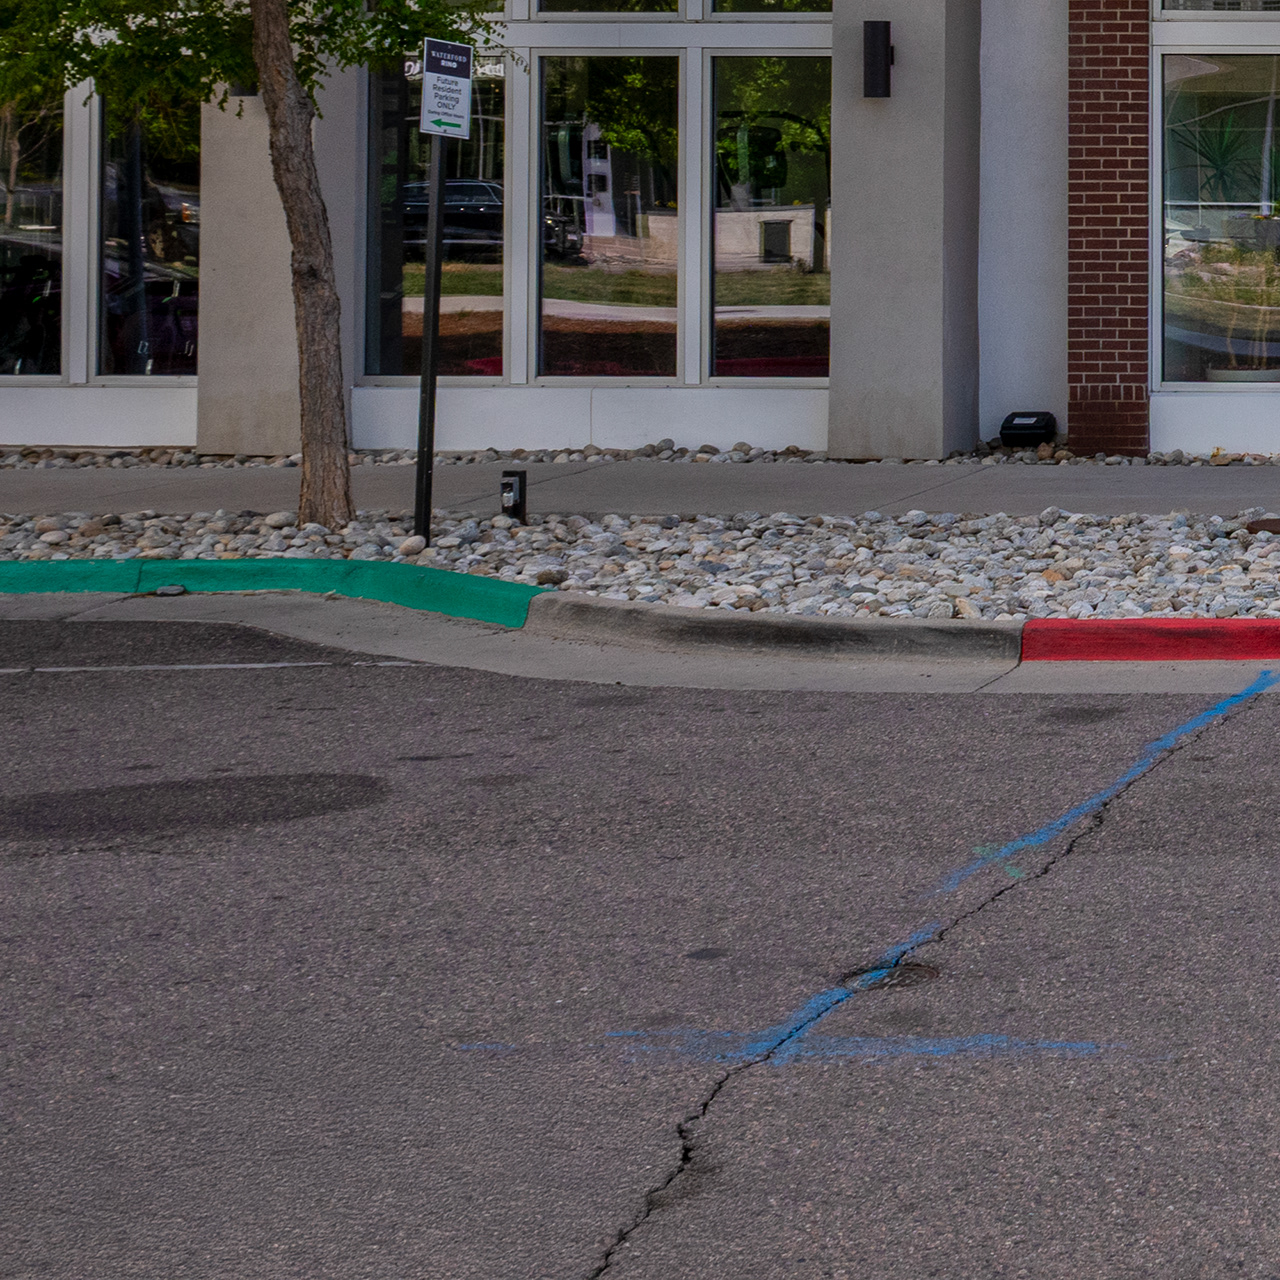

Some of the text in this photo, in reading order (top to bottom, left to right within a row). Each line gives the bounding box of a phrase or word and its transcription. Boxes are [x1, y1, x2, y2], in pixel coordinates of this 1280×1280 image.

[431, 50, 468, 63] WATERFORD
[440, 60, 458, 69] RINO
[437, 76, 459, 86] Future
[432, 84, 462, 95] Resident
[434, 92, 460, 104] Parking
[437, 101, 457, 110] ONLY
